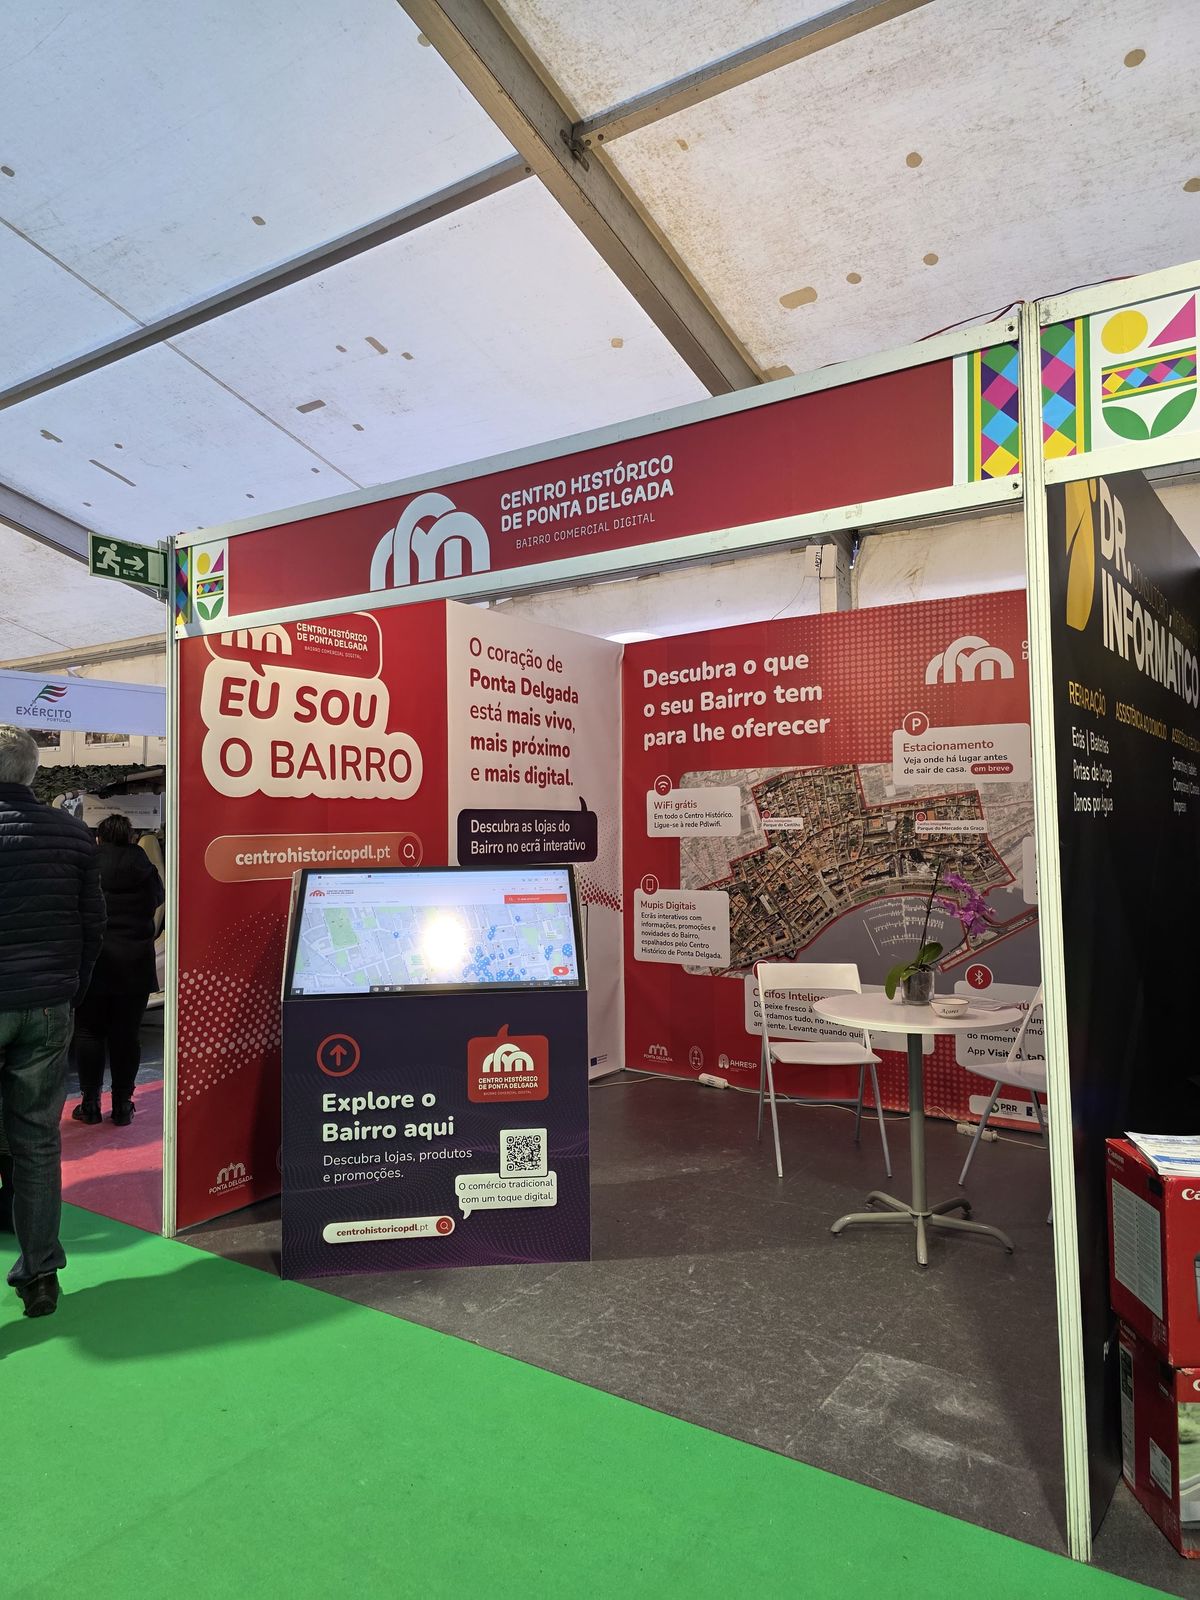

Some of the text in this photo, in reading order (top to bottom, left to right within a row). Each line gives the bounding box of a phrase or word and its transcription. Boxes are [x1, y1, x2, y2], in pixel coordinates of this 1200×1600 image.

[501, 454, 673, 511] CENTRO HISTÓRICO
[501, 478, 674, 532] DE PONTA DELGADA
[515, 513, 656, 549] BAIRRO COMERCIAL DIGITAL
[1099, 477, 1133, 584] DR.
[296, 622, 368, 643] CENTRO HISTÓRICO
[1101, 567, 1199, 709] INFORMÁTICO
[296, 632, 368, 652] DE PONTA DELGADA
[469, 636, 563, 674] O coração de
[643, 653, 810, 689] Descubra o que
[469, 668, 579, 705] Ponta Delgada
[219, 676, 378, 729] EU SOU
[643, 684, 823, 718] o seu Bairro tem
[16, 705, 72, 719] EXÉRCITO
[469, 701, 576, 734] está mais vivo,
[911, 718, 922, 731] P
[643, 717, 831, 752] para lhe oferecer
[470, 733, 571, 758] mais próximo
[903, 739, 995, 753] Estacionamento
[219, 737, 412, 784] O BAIRRO
[903, 753, 1008, 766] Veja onde há lugar antes
[470, 763, 574, 789] e mais digital.
[903, 763, 1011, 775] de sair de casa. em breve
[653, 799, 698, 811] WiFi grátis
[684, 812, 704, 820] Centro
[705, 810, 734, 819] Histórico.
[470, 819, 571, 837] Descubra as lojas do
[653, 821, 679, 830] Ligue-se
[680, 820, 684, 828] à
[684, 820, 699, 828] rede
[470, 837, 586, 855] Bairro no ecrã interativo
[235, 844, 391, 867] centrohistoricopdl.pt
[640, 900, 697, 912] Mupis Digitais
[657, 912, 688, 921] interativos
[641, 930, 670, 938] novidades
[678, 923, 711, 932] promoções
[641, 939, 710, 949] espalhados pelo Centro
[641, 948, 667, 956] Histórico
[752, 987, 786, 1001] Ccifos
[764, 1003, 784, 1011] peixe
[784, 1005, 807, 1013] fresco
[753, 1010, 793, 1022] Gurdamos
[794, 1015, 813, 1024] tudo,
[788, 1024, 818, 1034] Levante
[819, 1028, 848, 1038] quando
[980, 1034, 1019, 1043] moment
[967, 1046, 986, 1056] App
[730, 1059, 758, 1069] AHRESP
[503, 1075, 539, 1083] HISTÓRICO
[322, 1090, 437, 1115] Explore o
[1000, 1103, 1018, 1112] PRR
[322, 1115, 455, 1143] Bairro aqui
[322, 1148, 473, 1167] Descubra lojas, produtos
[208, 1183, 229, 1195] PONTA
[228, 1174, 254, 1188] DELGADA
[322, 1167, 405, 1185] e promoções.
[458, 1177, 554, 1191] O comércio tradicional
[461, 1190, 554, 1205] com um toque digital.
[336, 1221, 429, 1238] centrohistoricopdl.pt
